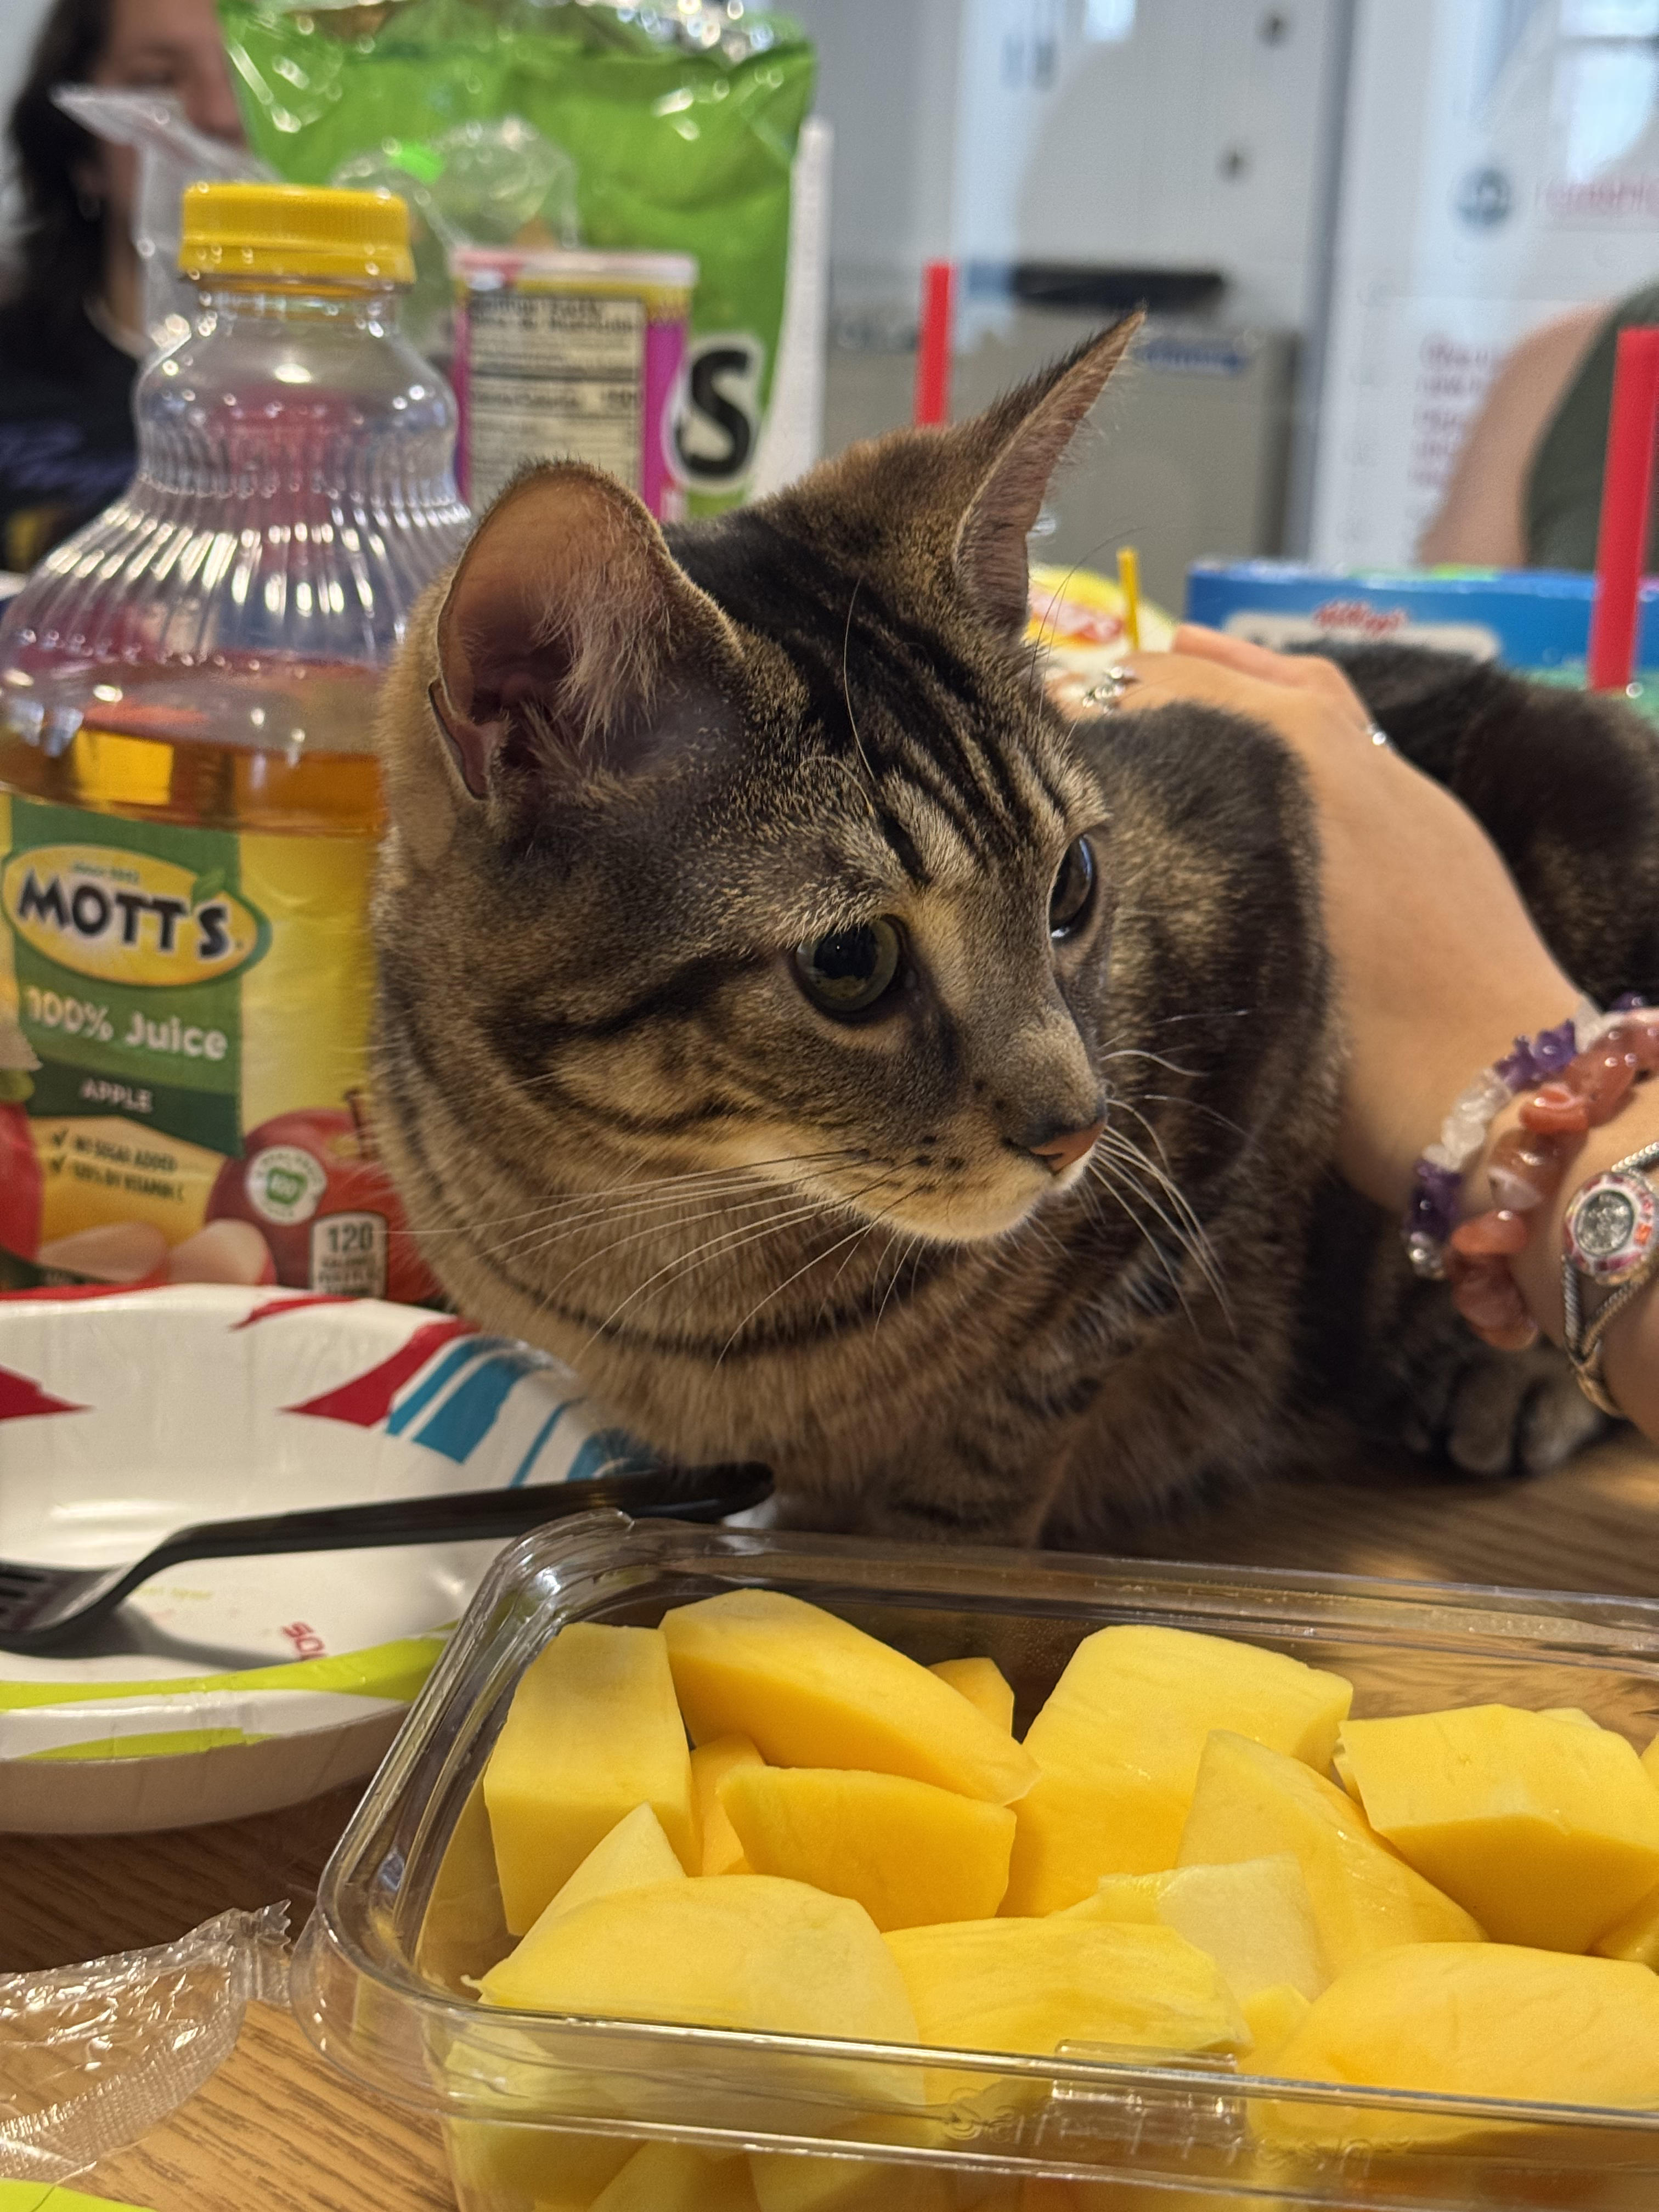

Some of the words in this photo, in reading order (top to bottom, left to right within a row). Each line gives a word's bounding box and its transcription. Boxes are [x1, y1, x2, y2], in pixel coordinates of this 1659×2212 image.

[26, 985, 114, 1042] 100%
[125, 1010, 228, 1062] Juice
[80, 1078, 154, 1114] APPLE
[328, 1222, 374, 1253] 120
